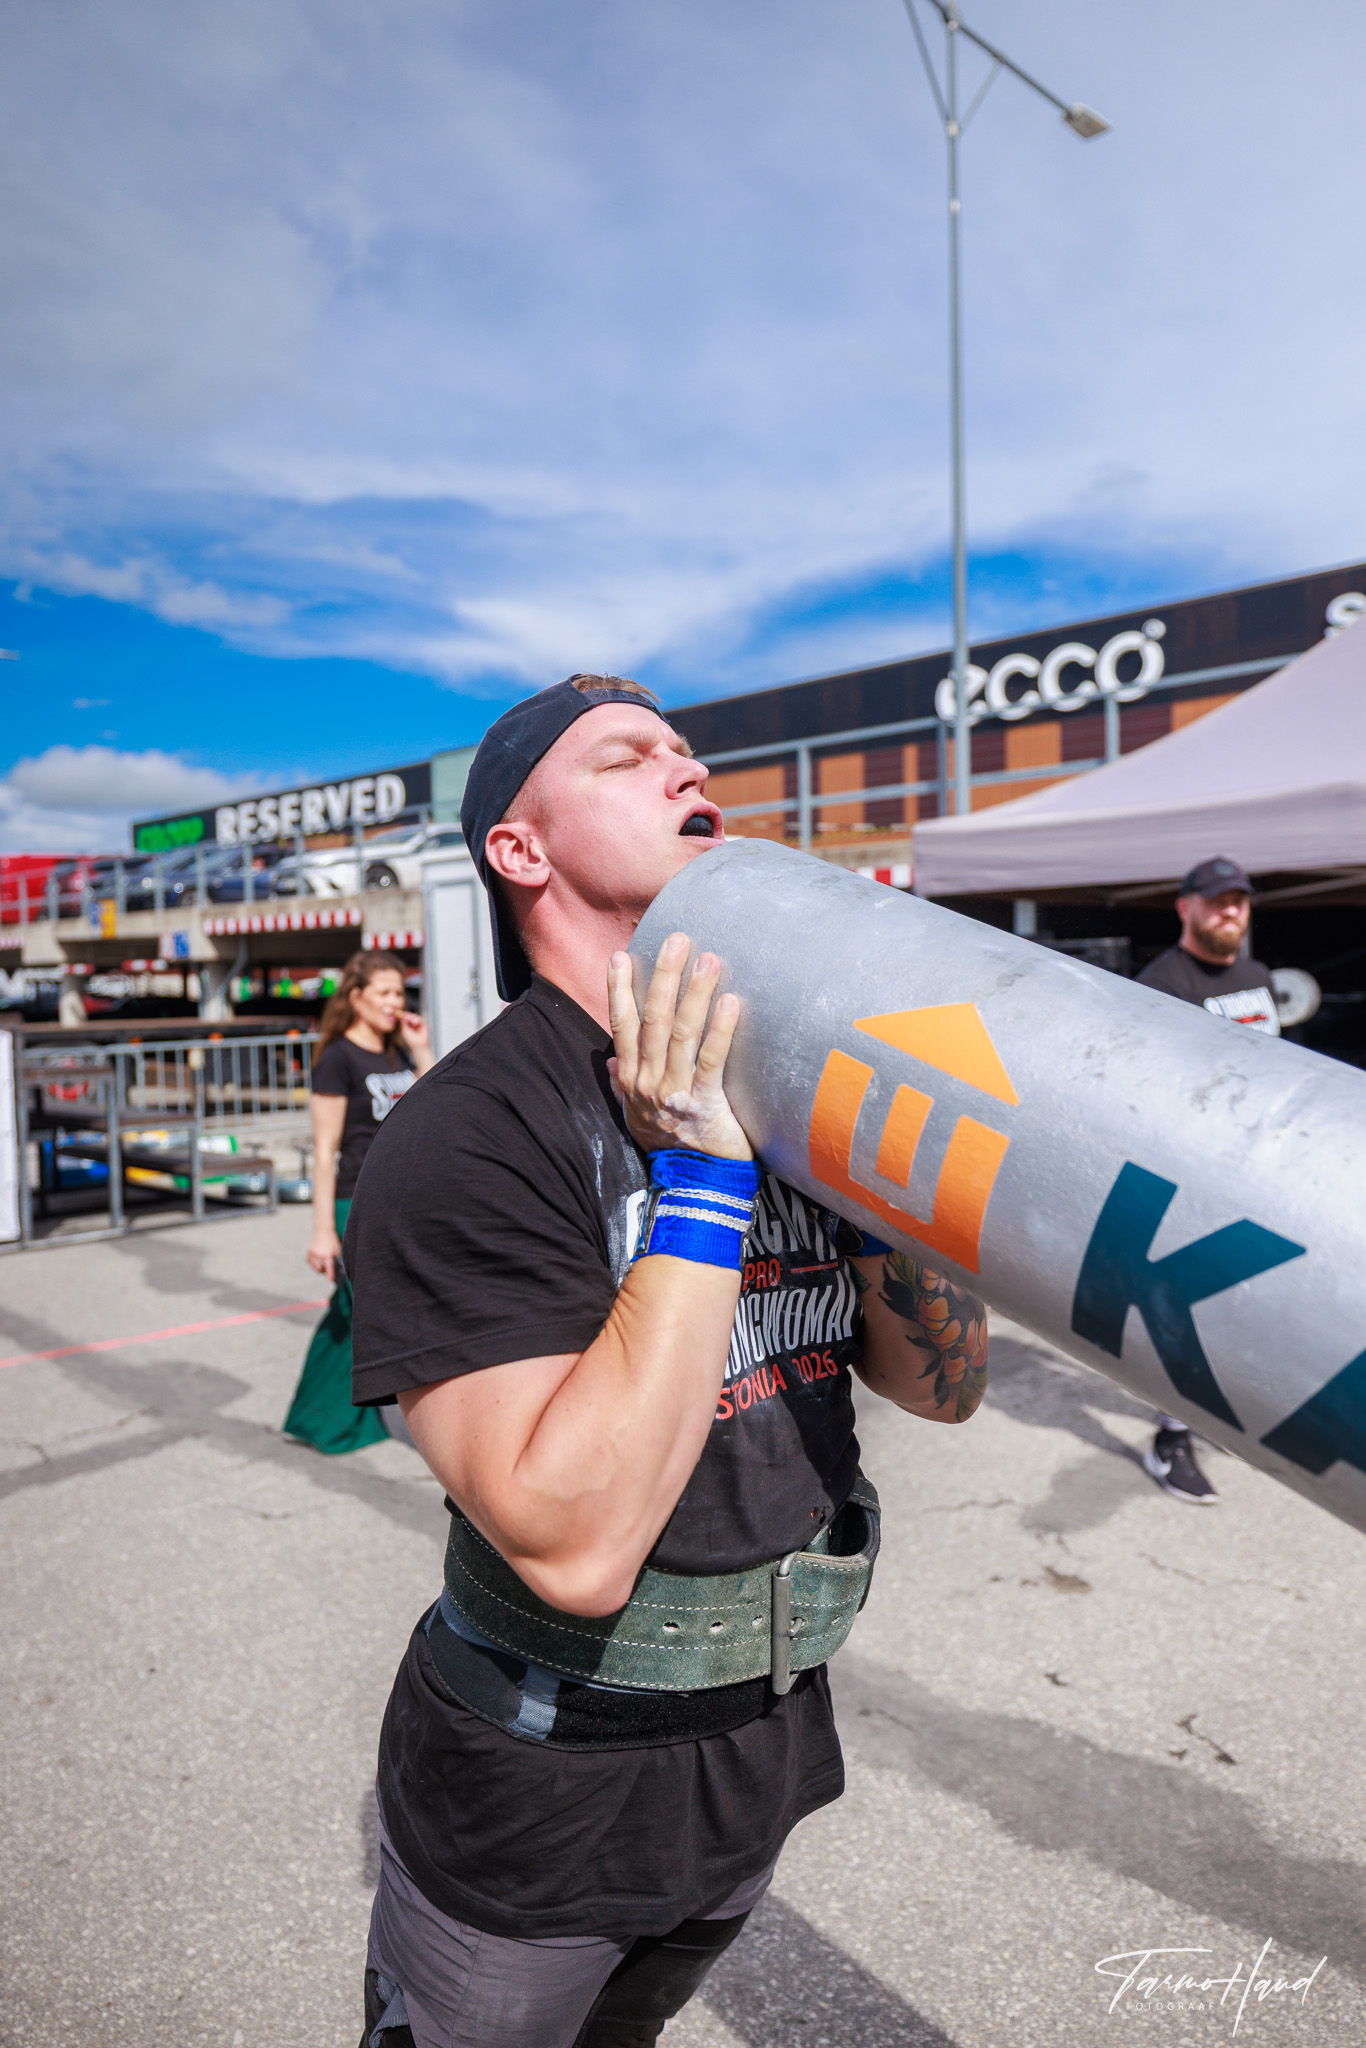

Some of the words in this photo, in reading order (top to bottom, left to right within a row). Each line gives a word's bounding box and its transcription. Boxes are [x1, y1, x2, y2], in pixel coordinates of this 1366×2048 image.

[935, 626, 1165, 727] ecco
[215, 774, 406, 850] RESERVED
[742, 1258, 781, 1291] PRO
[715, 1363, 787, 1420] STONIA
